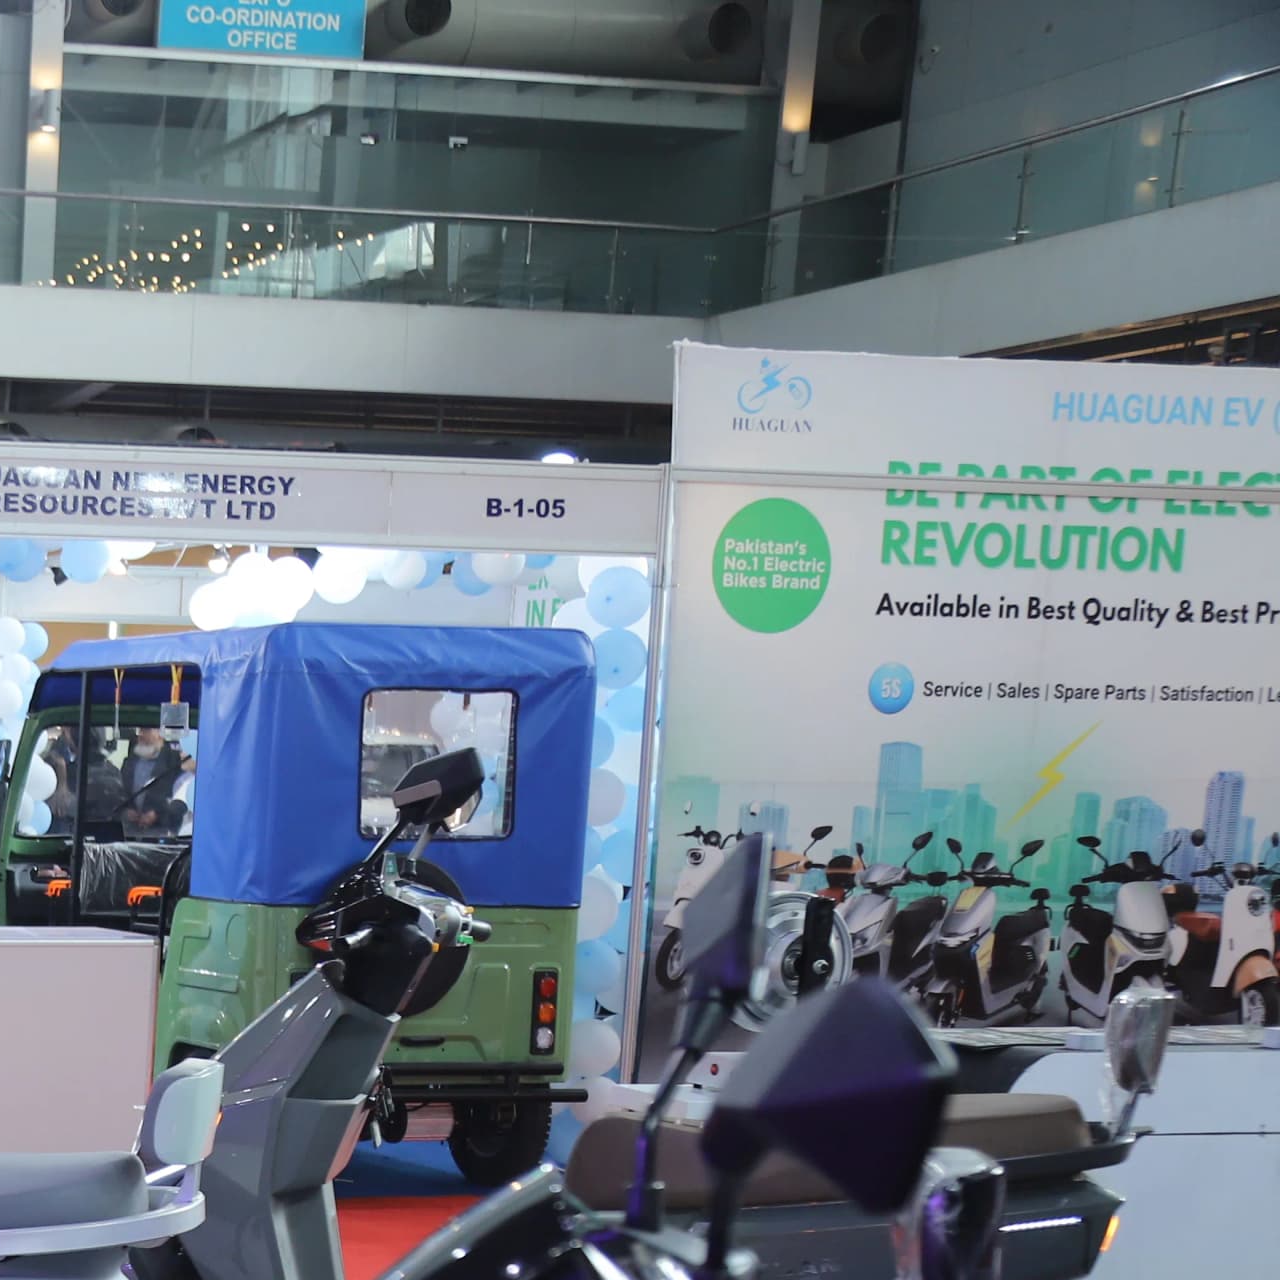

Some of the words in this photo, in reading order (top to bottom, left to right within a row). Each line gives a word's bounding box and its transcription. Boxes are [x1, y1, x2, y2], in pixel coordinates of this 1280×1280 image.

[186, 5, 340, 31] CO-ORDINATION
[227, 29, 297, 50] OFFICE
[1051, 391, 1214, 427] HUAGUAN
[1222, 396, 1265, 427] EV
[732, 417, 813, 433] HUAGUAN
[184, 473, 296, 497] ENERGY
[884, 461, 942, 508] BE
[954, 463, 1077, 512] PART
[1086, 467, 1153, 514] OF
[1163, 470, 1280, 518] ELEC
[162, 498, 219, 519] VT
[226, 499, 276, 521] LTD
[486, 497, 566, 519] B-1-05
[724, 538, 808, 555] Pakistan's
[880, 519, 1186, 574] REVOLUTION
[723, 556, 758, 571] No.1
[764, 557, 826, 573] Electric
[723, 572, 767, 588] Bikes
[772, 574, 820, 590] Brand
[875, 593, 992, 619] Available
[998, 595, 1020, 619] in
[1027, 597, 1076, 621] Best
[1082, 598, 1170, 629] Quality
[1175, 600, 1195, 624] &
[1200, 600, 1249, 624] Best
[880, 678, 901, 699] 5S
[922, 681, 983, 699] Service
[996, 682, 1040, 700] Sales
[1053, 683, 1100, 703] Spare
[1104, 683, 1147, 701] Parts
[1159, 684, 1254, 703] Satisfaction
